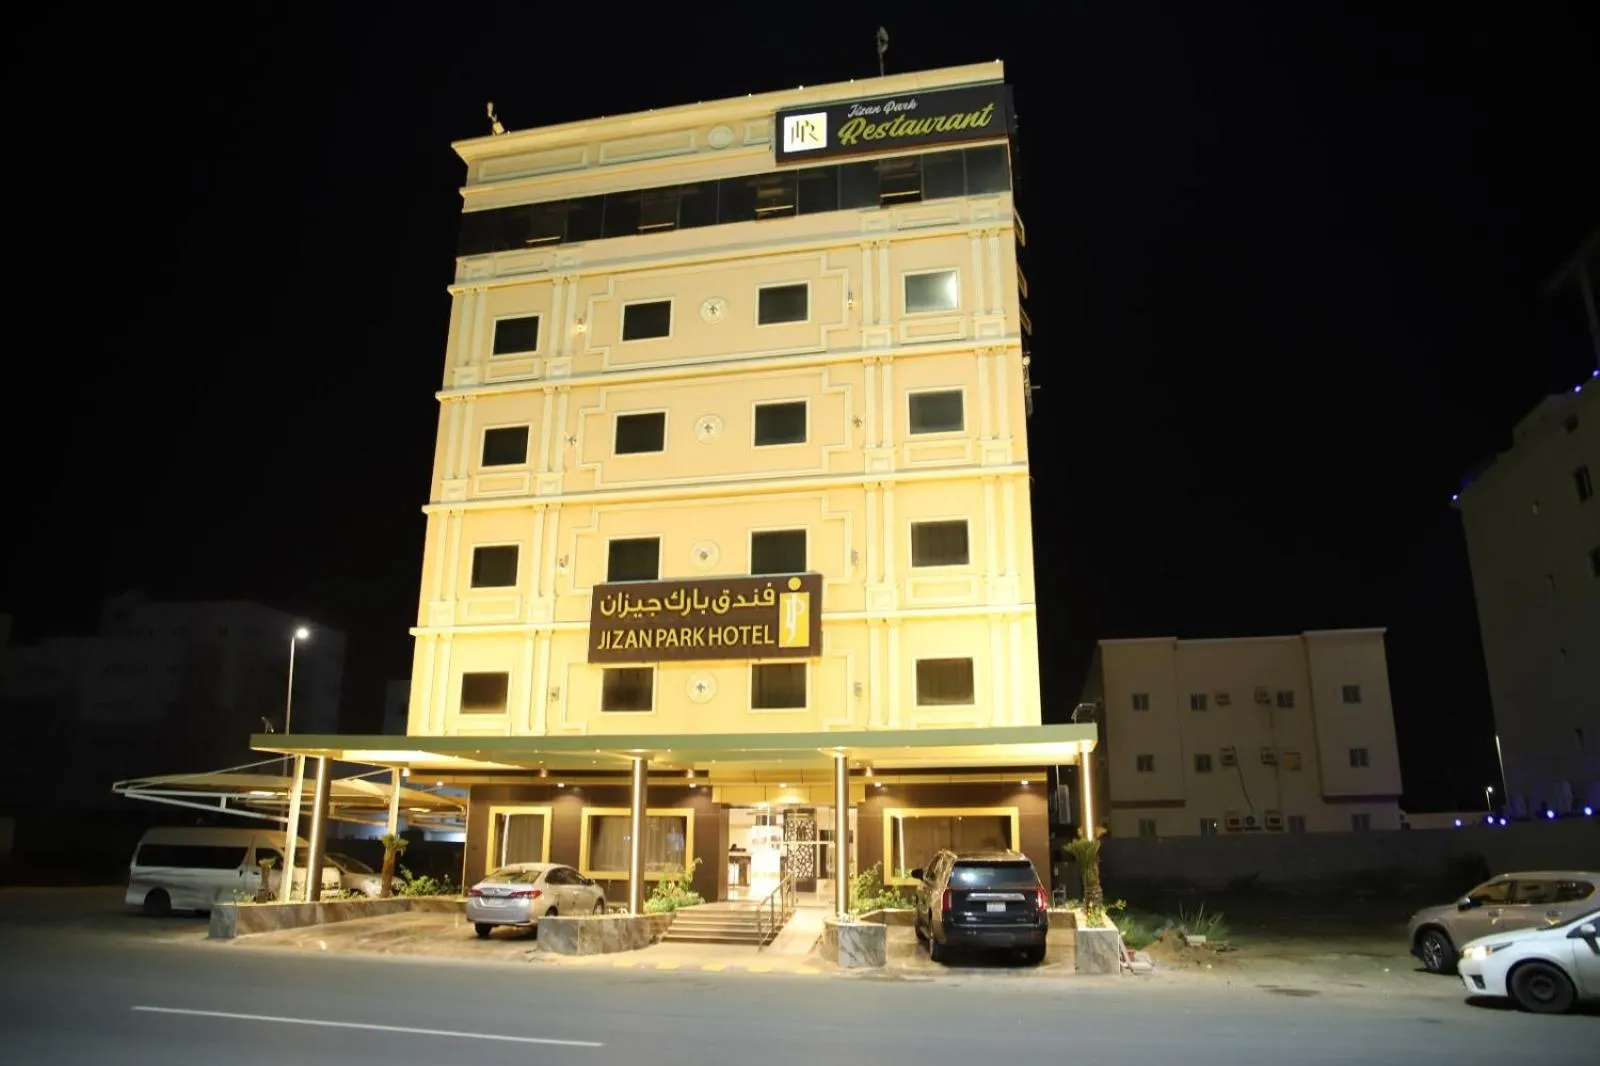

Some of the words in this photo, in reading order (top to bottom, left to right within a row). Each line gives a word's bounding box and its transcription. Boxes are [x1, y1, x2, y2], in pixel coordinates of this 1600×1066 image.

[848, 104, 881, 118] Jizan
[883, 99, 917, 114] Park
[837, 102, 996, 146] Restaurant
[599, 592, 662, 618] جيزان
[664, 588, 710, 616] بارك
[712, 582, 776, 614] فندق
[597, 630, 653, 650] JIZAN
[655, 626, 706, 647] PARK
[708, 624, 775, 646] HOTEL
